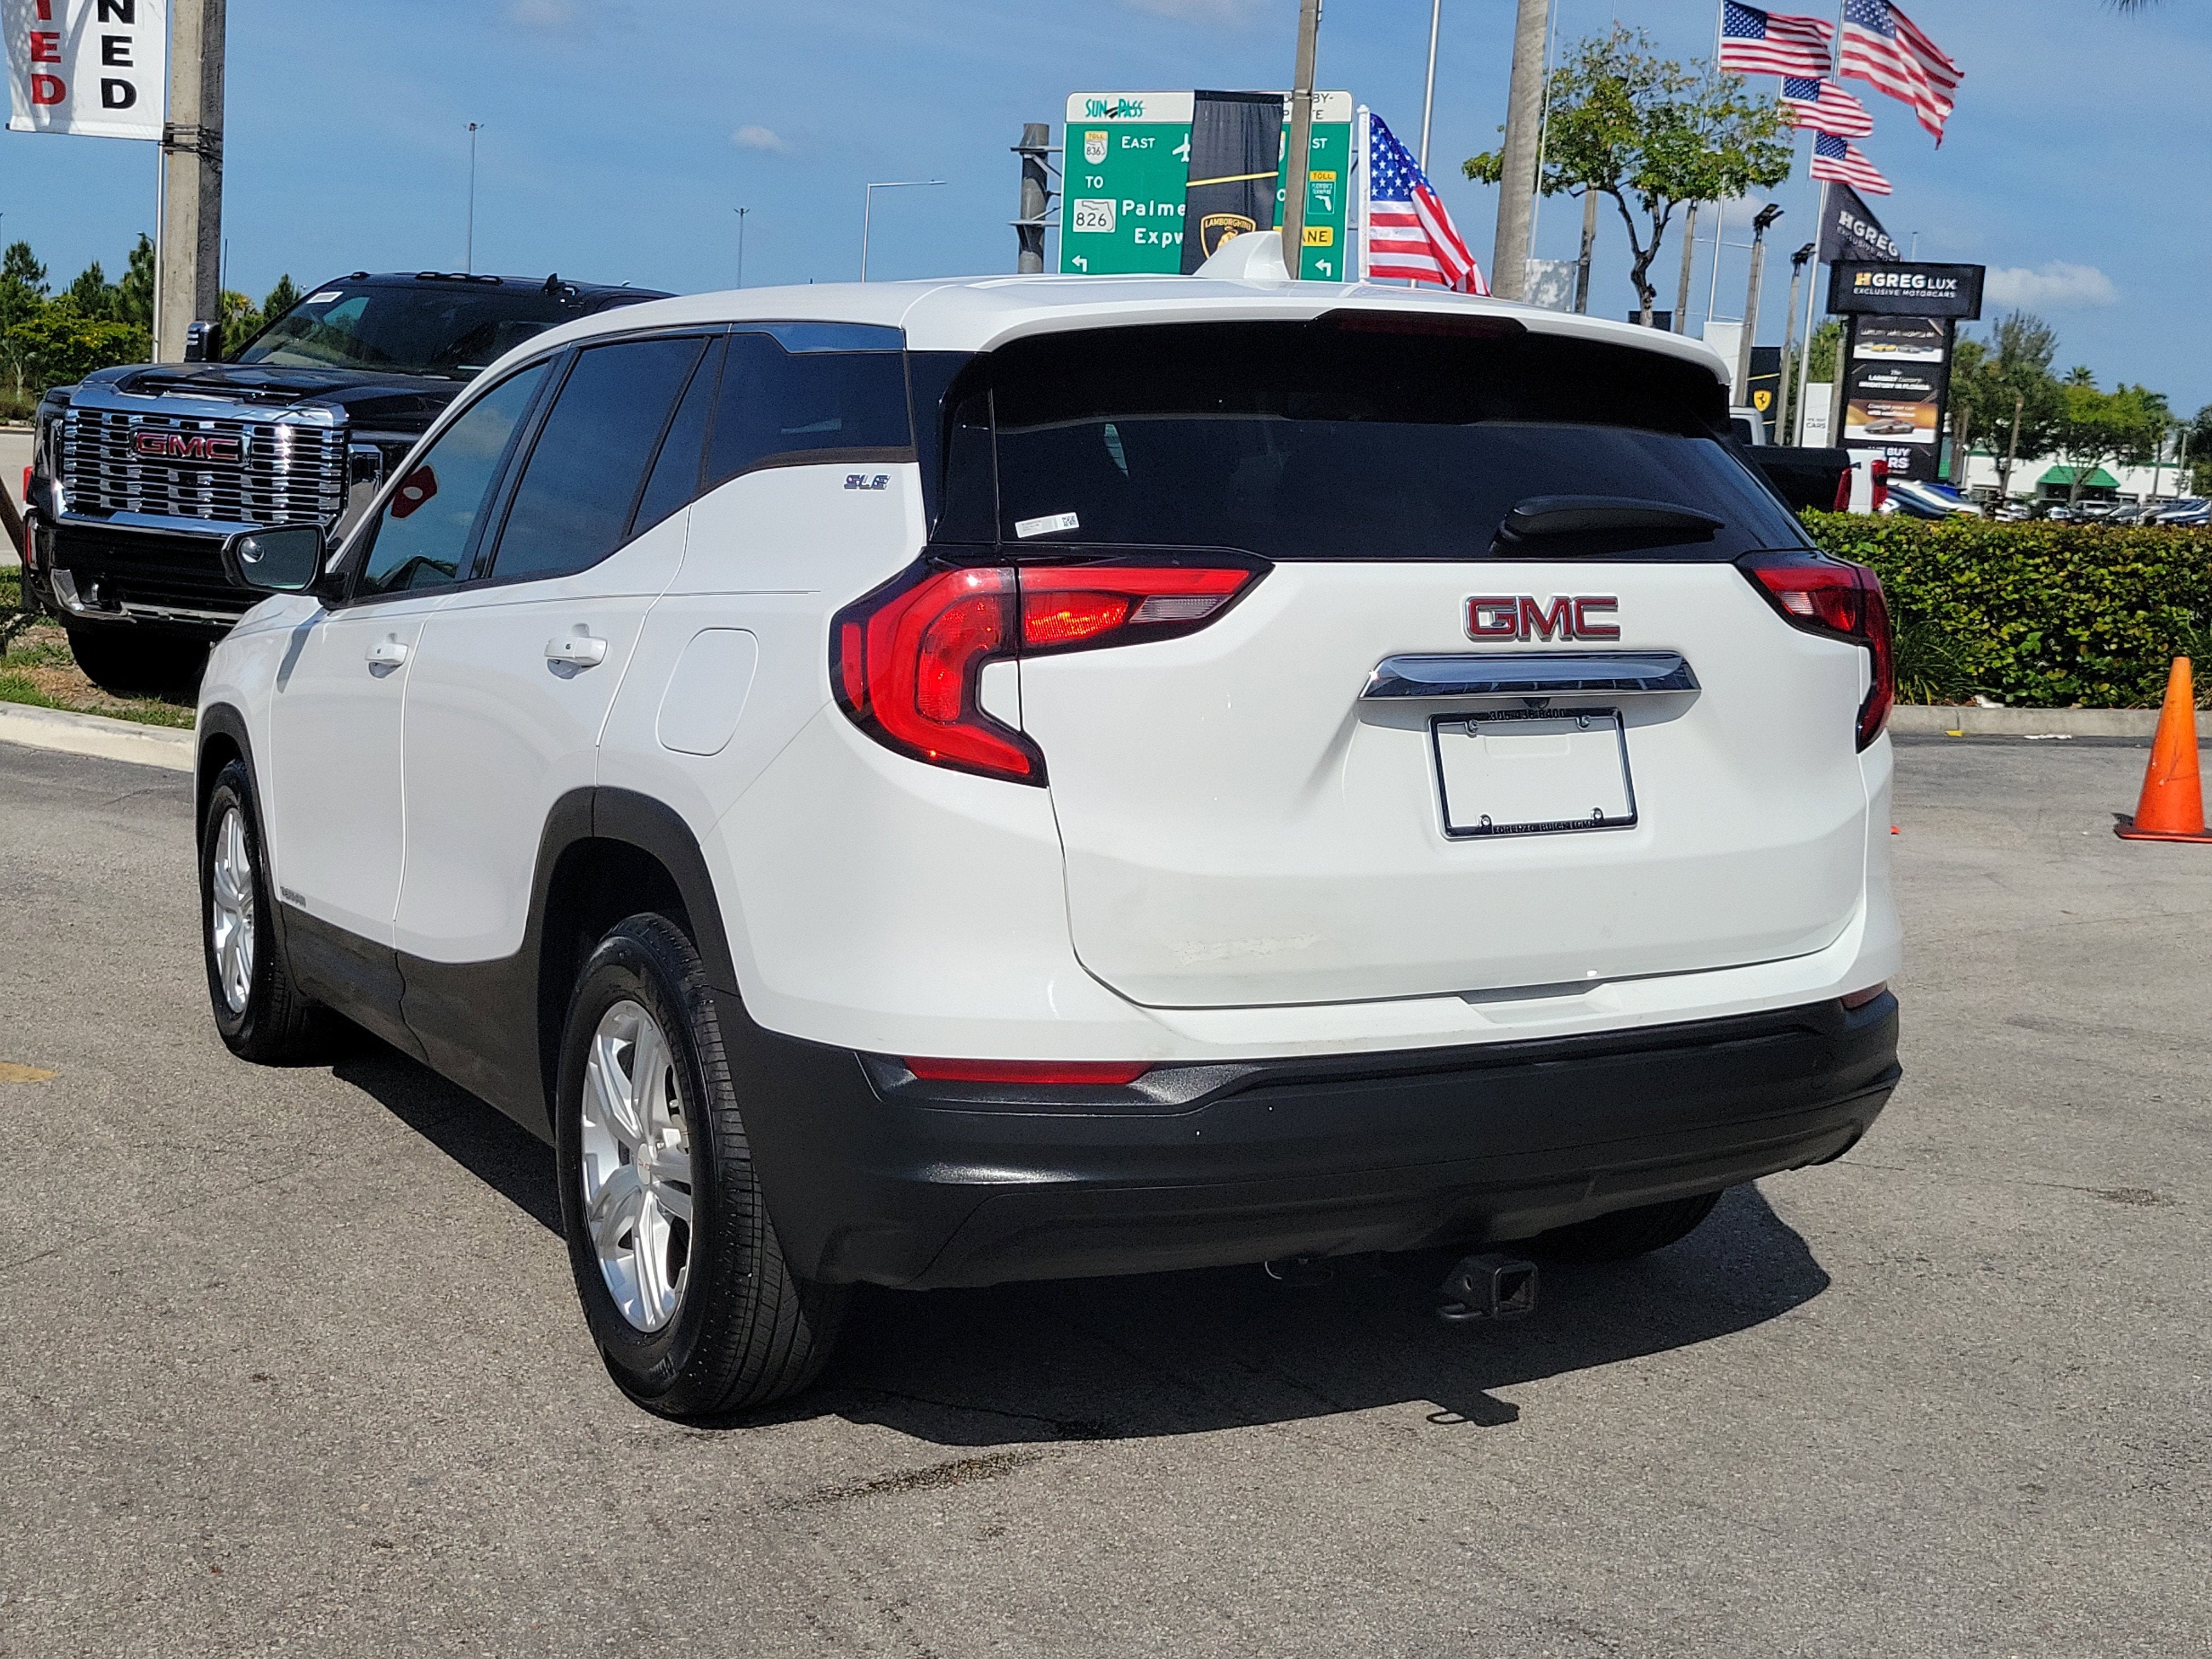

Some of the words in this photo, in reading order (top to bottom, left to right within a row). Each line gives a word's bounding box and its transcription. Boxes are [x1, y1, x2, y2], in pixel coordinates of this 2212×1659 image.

[1122, 136, 1155, 149] EAST
[1312, 138, 1328, 149] ST
[1085, 146, 1101, 156] 836
[1085, 176, 1104, 189] TO
[1122, 200, 1186, 216] Palme
[1076, 212, 1107, 227] 826
[1205, 218, 1251, 231] LAMBORGHINI
[1135, 228, 1184, 249] Expw
[1302, 230, 1328, 242] NE
[1928, 278, 1957, 290] LUX
[1853, 288, 1900, 296] EXCLUSIVE
[1902, 290, 1956, 298] MOTORCARS
[137, 432, 239, 461] GMC
[1887, 447, 1912, 456] BUY
[1888, 457, 1910, 469] RS
[844, 475, 890, 490] SLE
[1464, 596, 1621, 642] GMC
